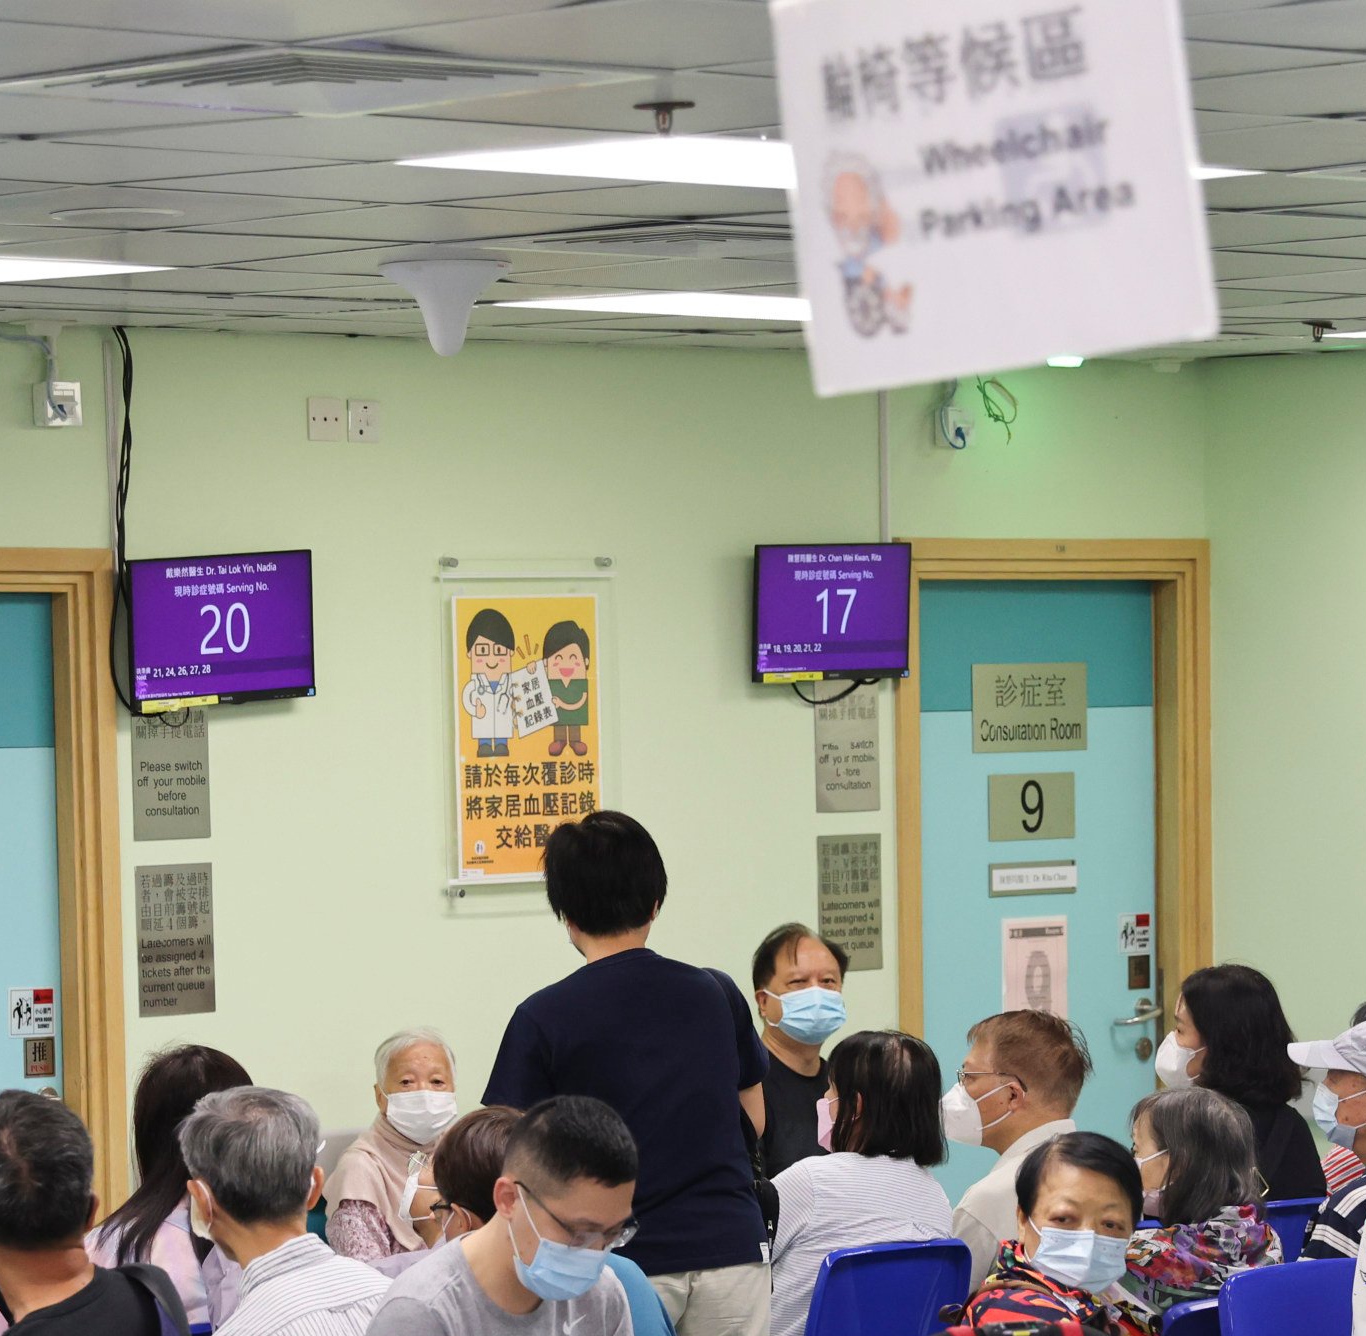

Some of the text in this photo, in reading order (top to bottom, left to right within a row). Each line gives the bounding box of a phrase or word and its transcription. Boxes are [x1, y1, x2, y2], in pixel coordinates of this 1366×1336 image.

[922, 116, 1109, 175] Wheelchair
[921, 182, 1134, 236] Parking Area
[205, 565, 217, 576] Dr.
[217, 565, 227, 575] Tai
[228, 564, 241, 575] Lok
[256, 562, 277, 573] Nadia
[838, 571, 862, 581] Serving
[863, 571, 874, 579] No.
[174, 581, 270, 598] 現時診症號碼 Serving No.
[816, 588, 857, 635] 17
[200, 602, 251, 655] 20
[813, 643, 822, 652] 22
[153, 664, 212, 679] 21, 28
[521, 677, 541, 696] 家居
[995, 673, 1067, 709] 診症室
[525, 691, 546, 710] 血壓
[980, 717, 1082, 743] Consultation Room
[140, 760, 203, 772] Please switch
[137, 775, 207, 790] off your mobile
[464, 760, 596, 789] 請於每次覆診時
[157, 790, 187, 802] before
[145, 805, 200, 817] consultation
[465, 790, 597, 821] 將家居血壓記錄
[1020, 779, 1045, 834] 9
[495, 823, 560, 850] 交給醫
[141, 934, 212, 949] Latecomers will
[155, 949, 205, 965] assigned 4
[142, 964, 211, 979] tickets after the
[142, 980, 206, 994] current queue
[142, 997, 178, 1008] number
